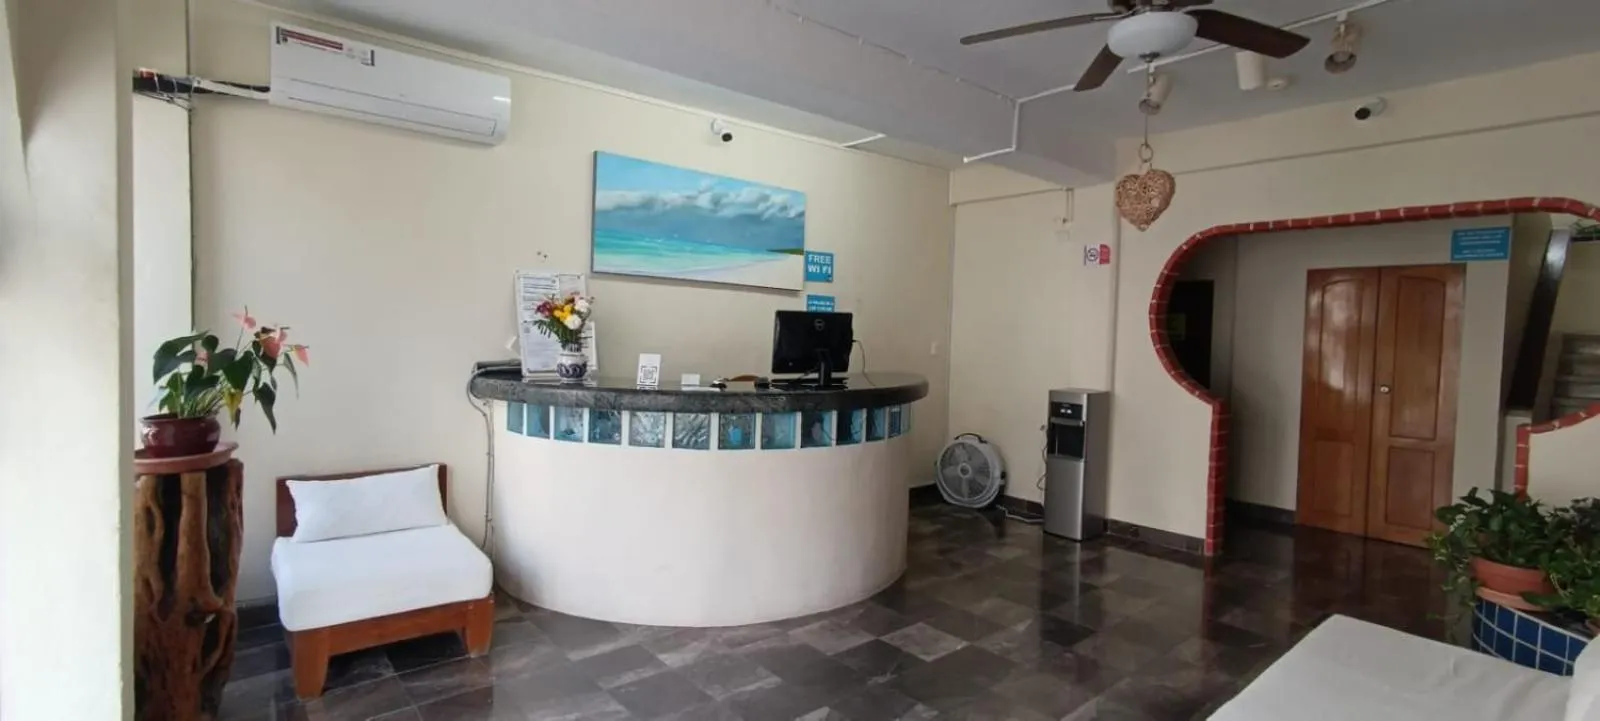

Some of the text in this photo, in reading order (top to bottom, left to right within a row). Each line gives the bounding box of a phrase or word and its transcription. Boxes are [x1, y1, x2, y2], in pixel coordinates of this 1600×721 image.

[807, 254, 832, 264] FREE
[807, 264, 832, 274] WI FI
